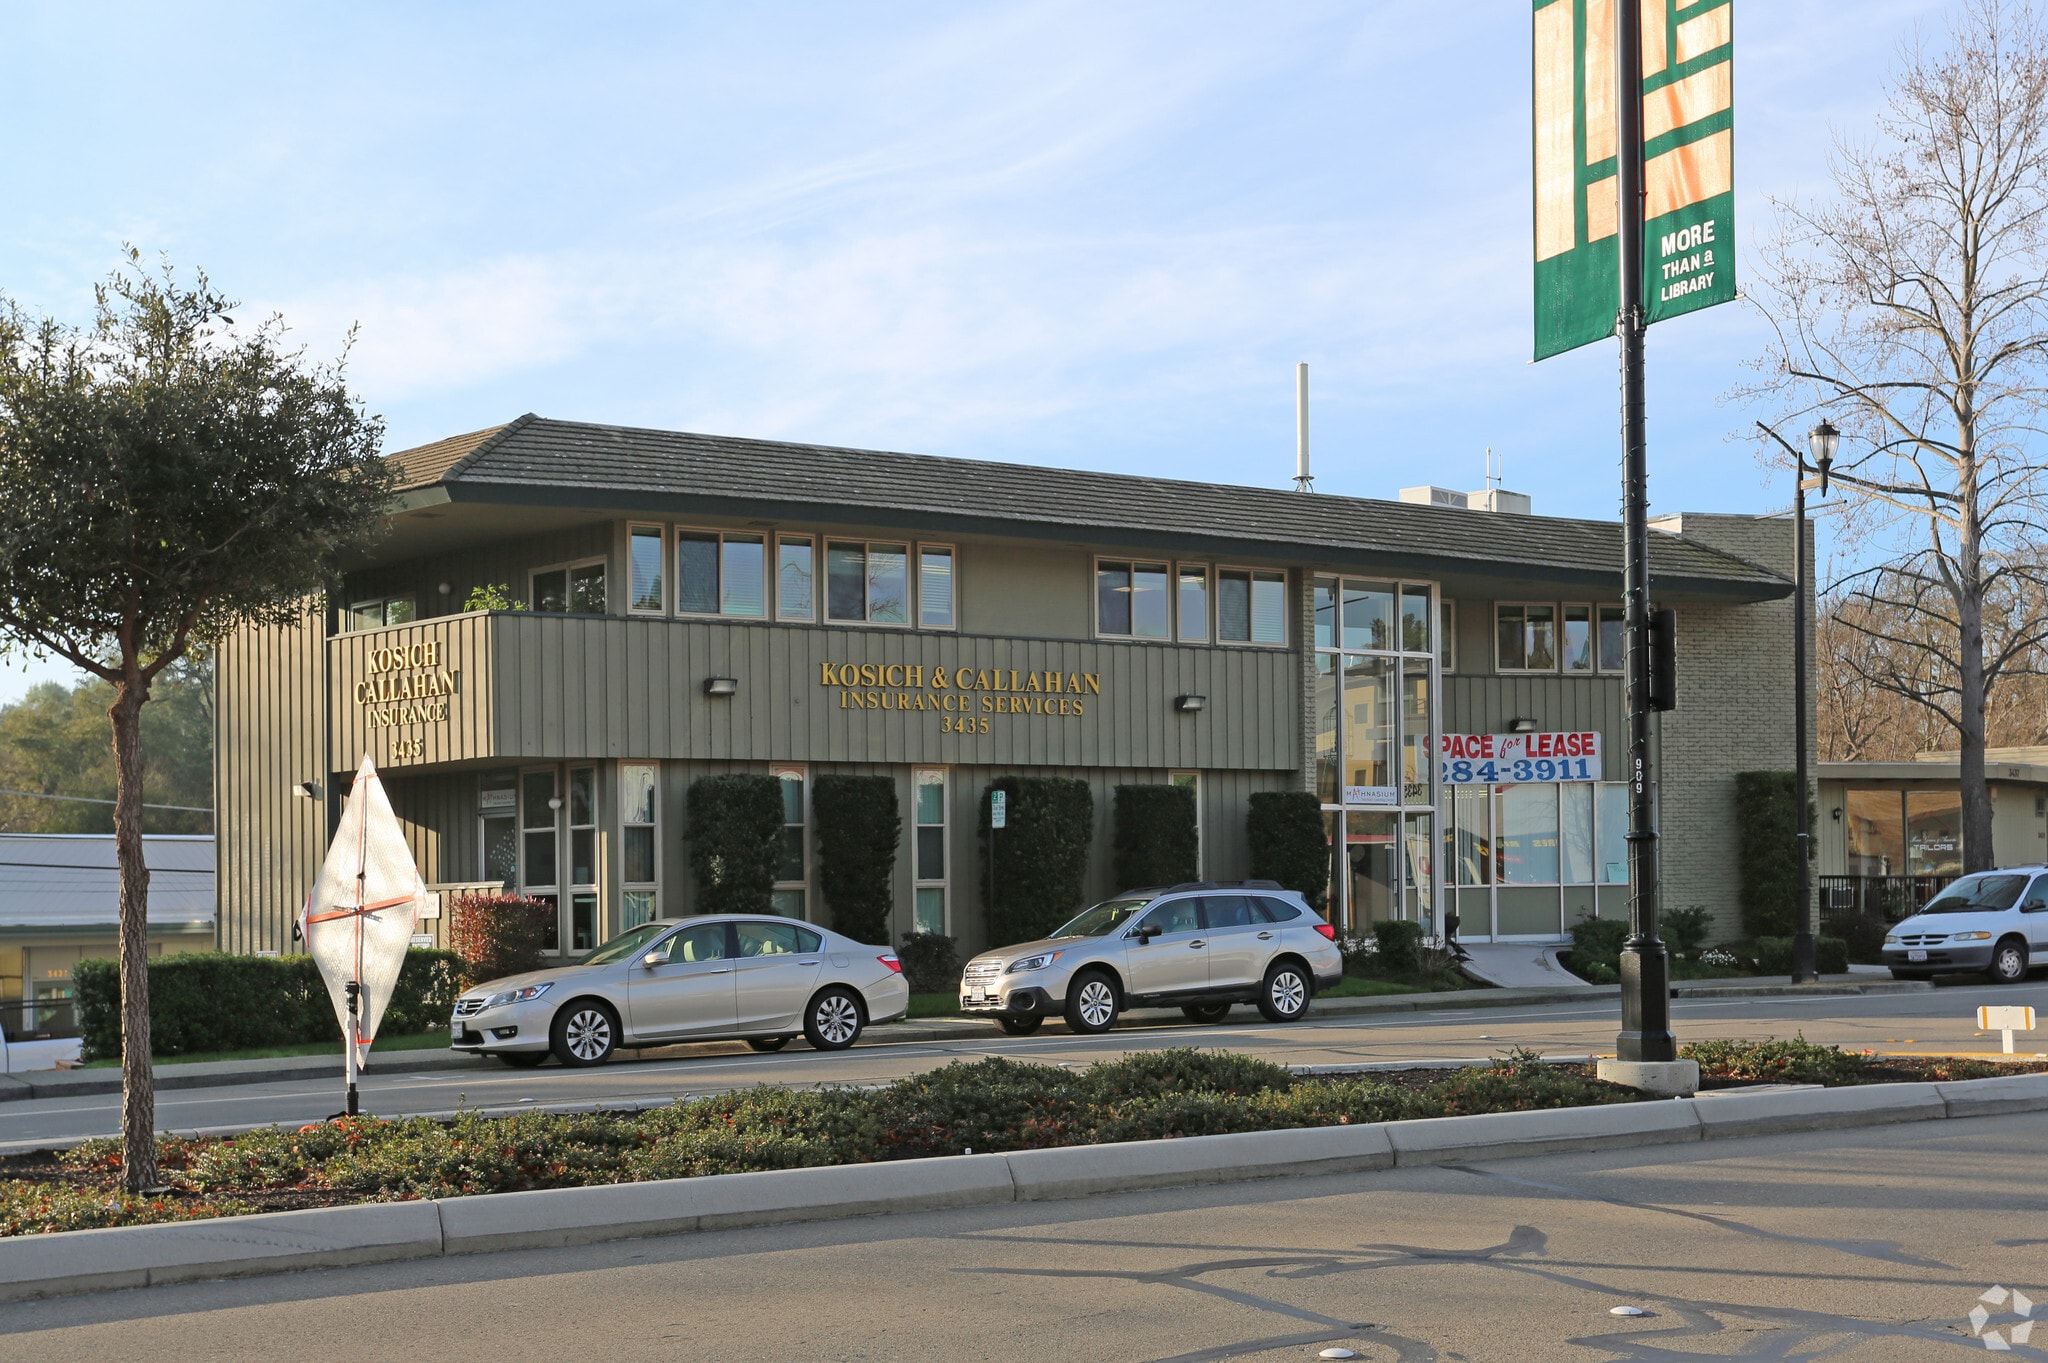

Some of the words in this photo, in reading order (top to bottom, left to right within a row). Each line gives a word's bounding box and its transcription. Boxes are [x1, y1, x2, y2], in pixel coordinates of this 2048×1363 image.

[1661, 219, 1715, 257] MORE
[1661, 253, 1700, 280] THAN
[1703, 249, 1714, 266] a
[1661, 271, 1714, 301] LIBRARY
[367, 641, 439, 674] KOSICH
[354, 669, 457, 705] CALLAHAN
[820, 662, 924, 688] KOSICH
[931, 666, 949, 689] &
[955, 667, 1101, 695] CALLAHAN
[367, 702, 446, 728] INSURANCE
[840, 691, 971, 712] INSURANCE
[982, 697, 1084, 716] SERVICES
[940, 715, 990, 734] 3435
[391, 738, 422, 759] 3435
[1499, 738, 1521, 759] for
[1525, 733, 1596, 758] LEASE
[1442, 758, 1592, 782] 84-3911
[1346, 788, 1395, 799] MATHNASIUM
